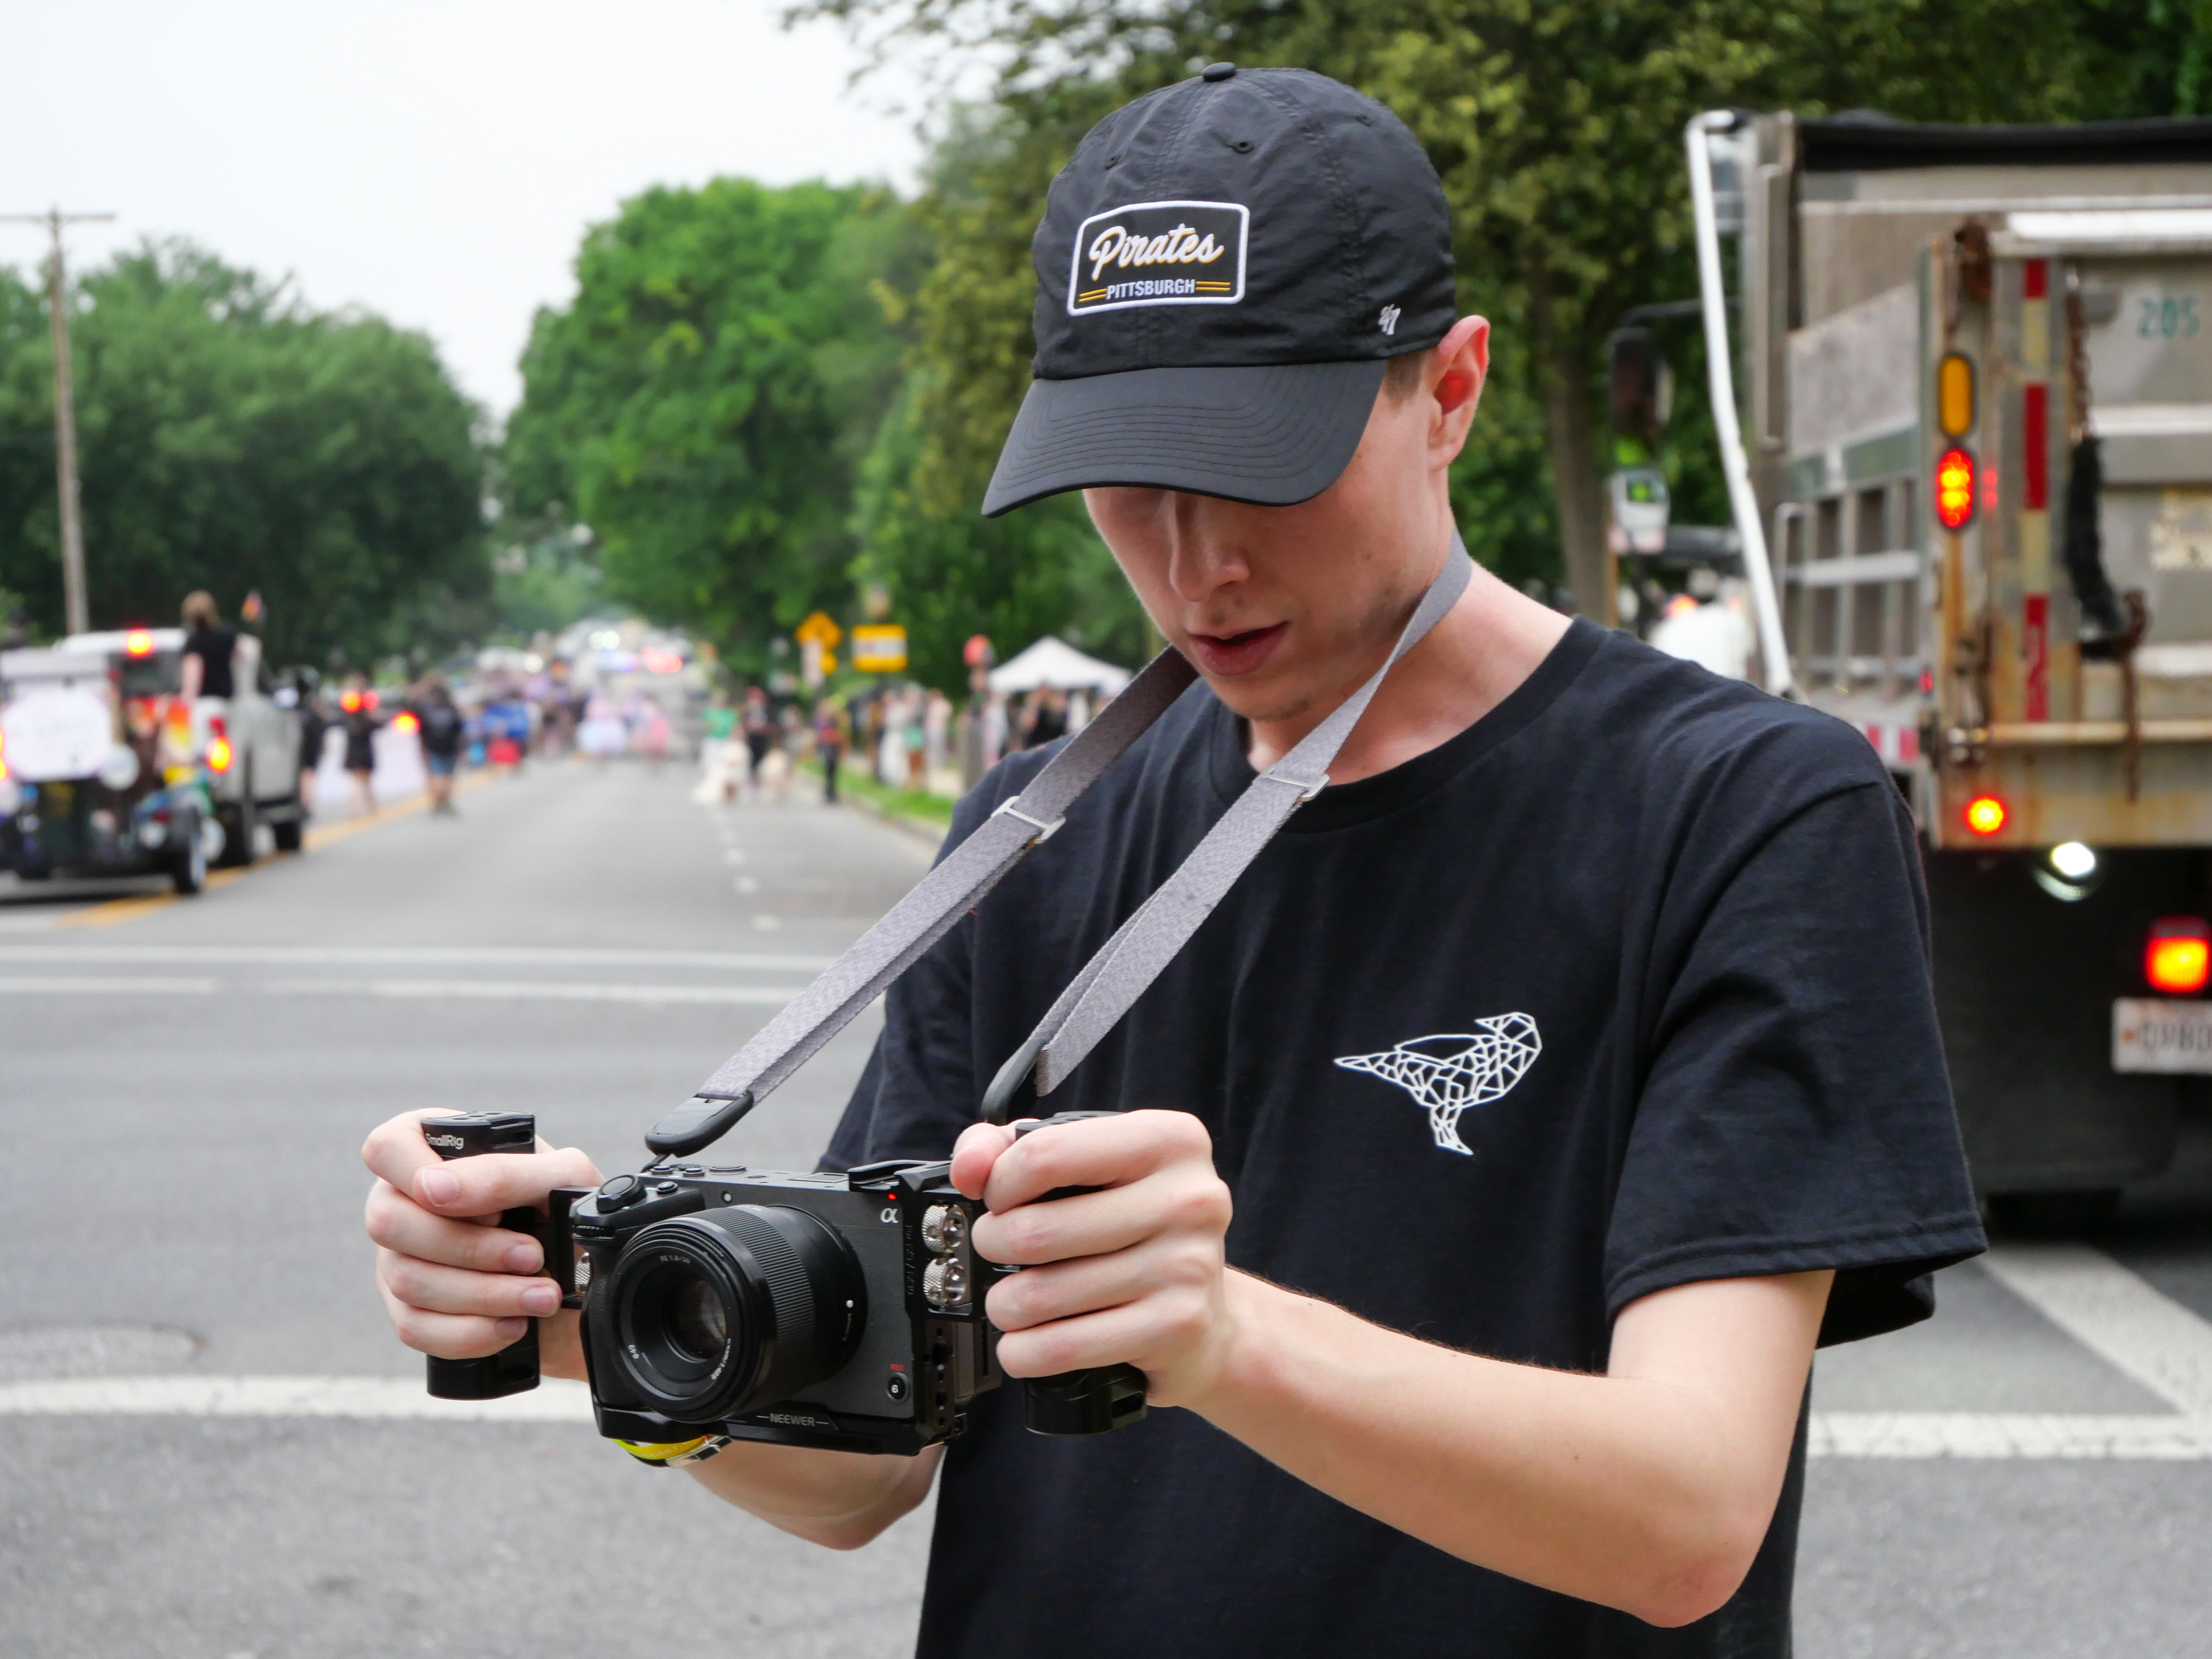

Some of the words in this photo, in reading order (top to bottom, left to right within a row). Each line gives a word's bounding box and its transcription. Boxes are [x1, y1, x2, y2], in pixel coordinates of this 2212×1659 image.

[1089, 223, 1225, 281] Pirates
[1106, 278, 1196, 300] PITTSBURGH
[425, 1133, 464, 1149] SmallRig
[891, 1384, 899, 1394] 6
[770, 1413, 815, 1427] NEEWER
